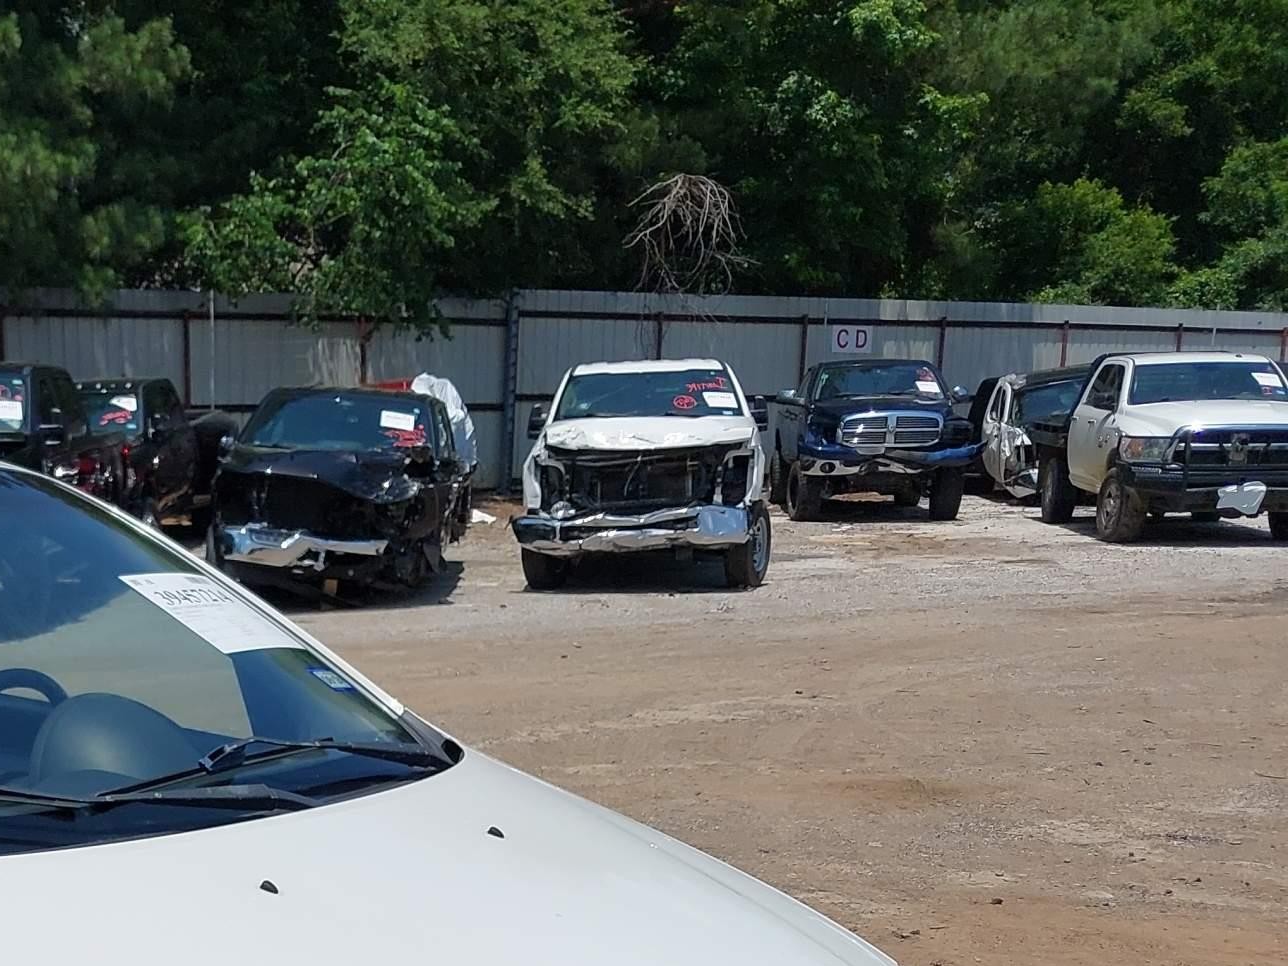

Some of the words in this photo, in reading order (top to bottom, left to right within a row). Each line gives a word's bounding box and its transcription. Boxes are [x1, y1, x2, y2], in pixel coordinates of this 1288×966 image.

[836, 328, 849, 349] C
[855, 328, 868, 349] D
[154, 588, 236, 607] 39457214
